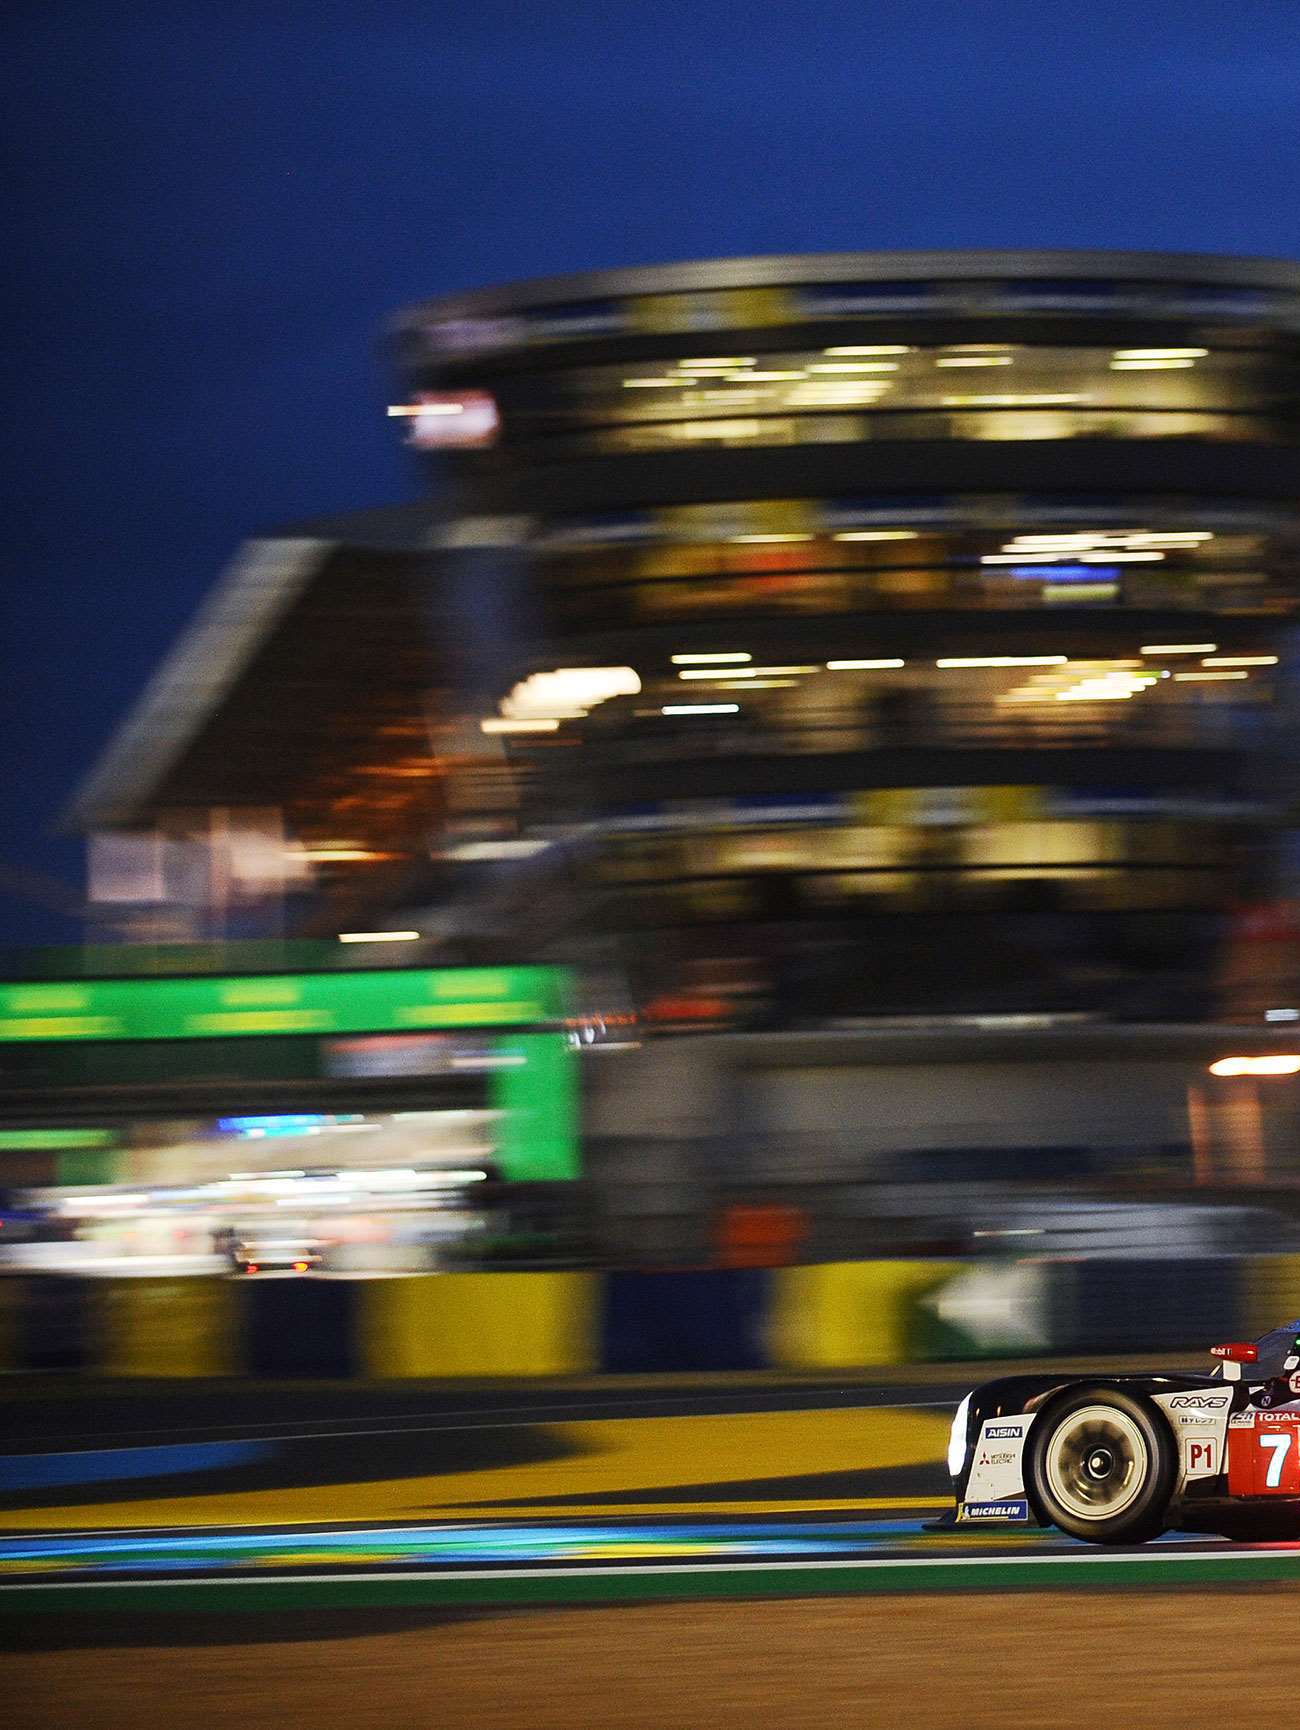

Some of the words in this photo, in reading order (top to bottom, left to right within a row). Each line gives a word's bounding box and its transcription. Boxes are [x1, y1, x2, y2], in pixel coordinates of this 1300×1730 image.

[1170, 1397, 1228, 1408] RAYS
[1258, 1412, 1300, 1421] TOTAL
[987, 1428, 1020, 1437] AISIN
[1190, 1444, 1211, 1468] P1
[1260, 1433, 1292, 1487] 7
[971, 1506, 1020, 1516] MICHELIN
